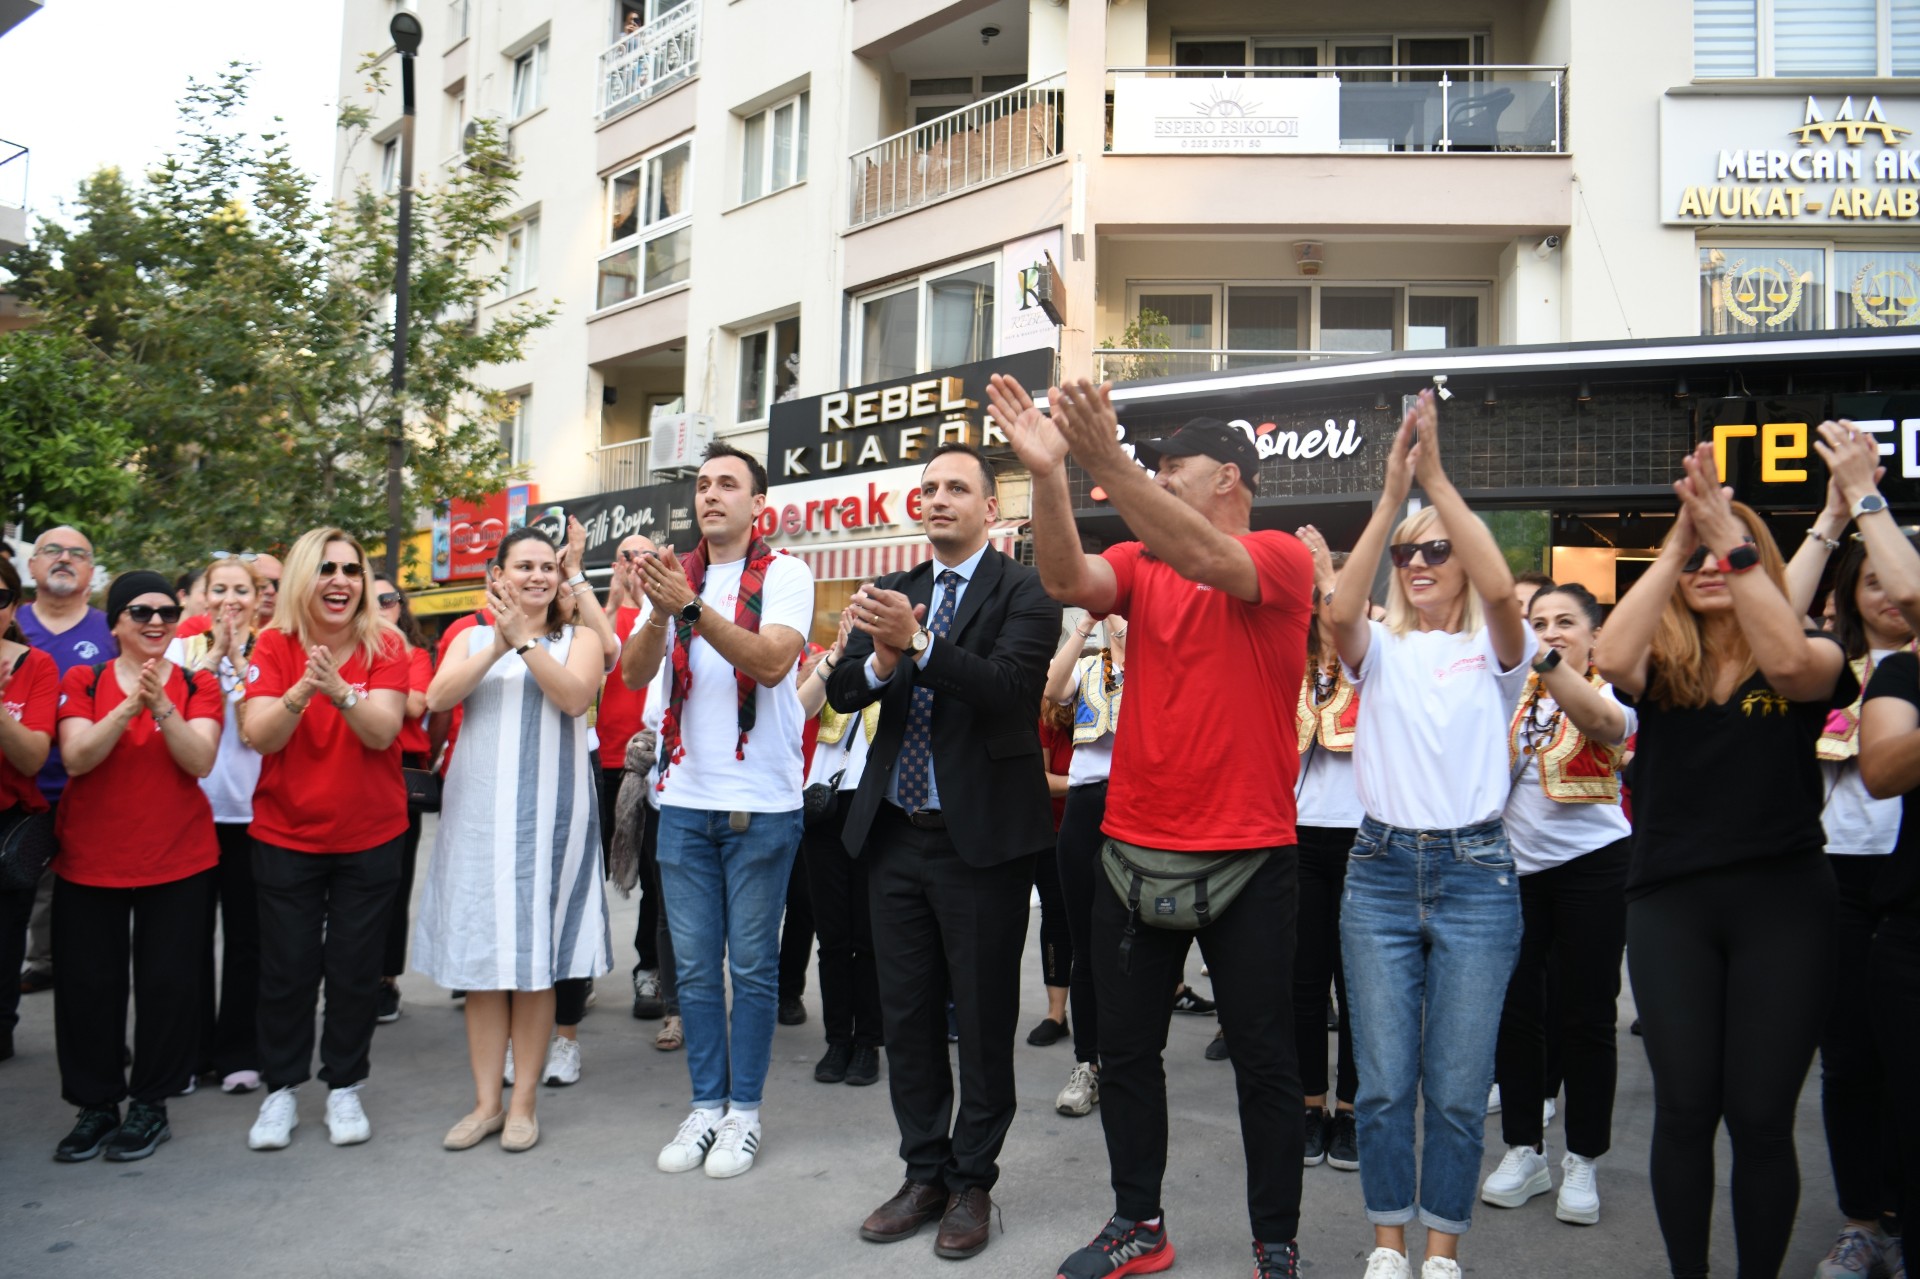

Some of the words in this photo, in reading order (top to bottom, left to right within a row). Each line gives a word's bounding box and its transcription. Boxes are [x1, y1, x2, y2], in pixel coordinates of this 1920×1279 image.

[1154, 120, 1216, 134] ESPERO
[1717, 149, 1861, 180] MERCAN
[819, 376, 969, 433] REBEL
[783, 413, 1010, 477] KUAFÖR
[584, 509, 610, 550] Filli
[610, 504, 655, 539] Boya
